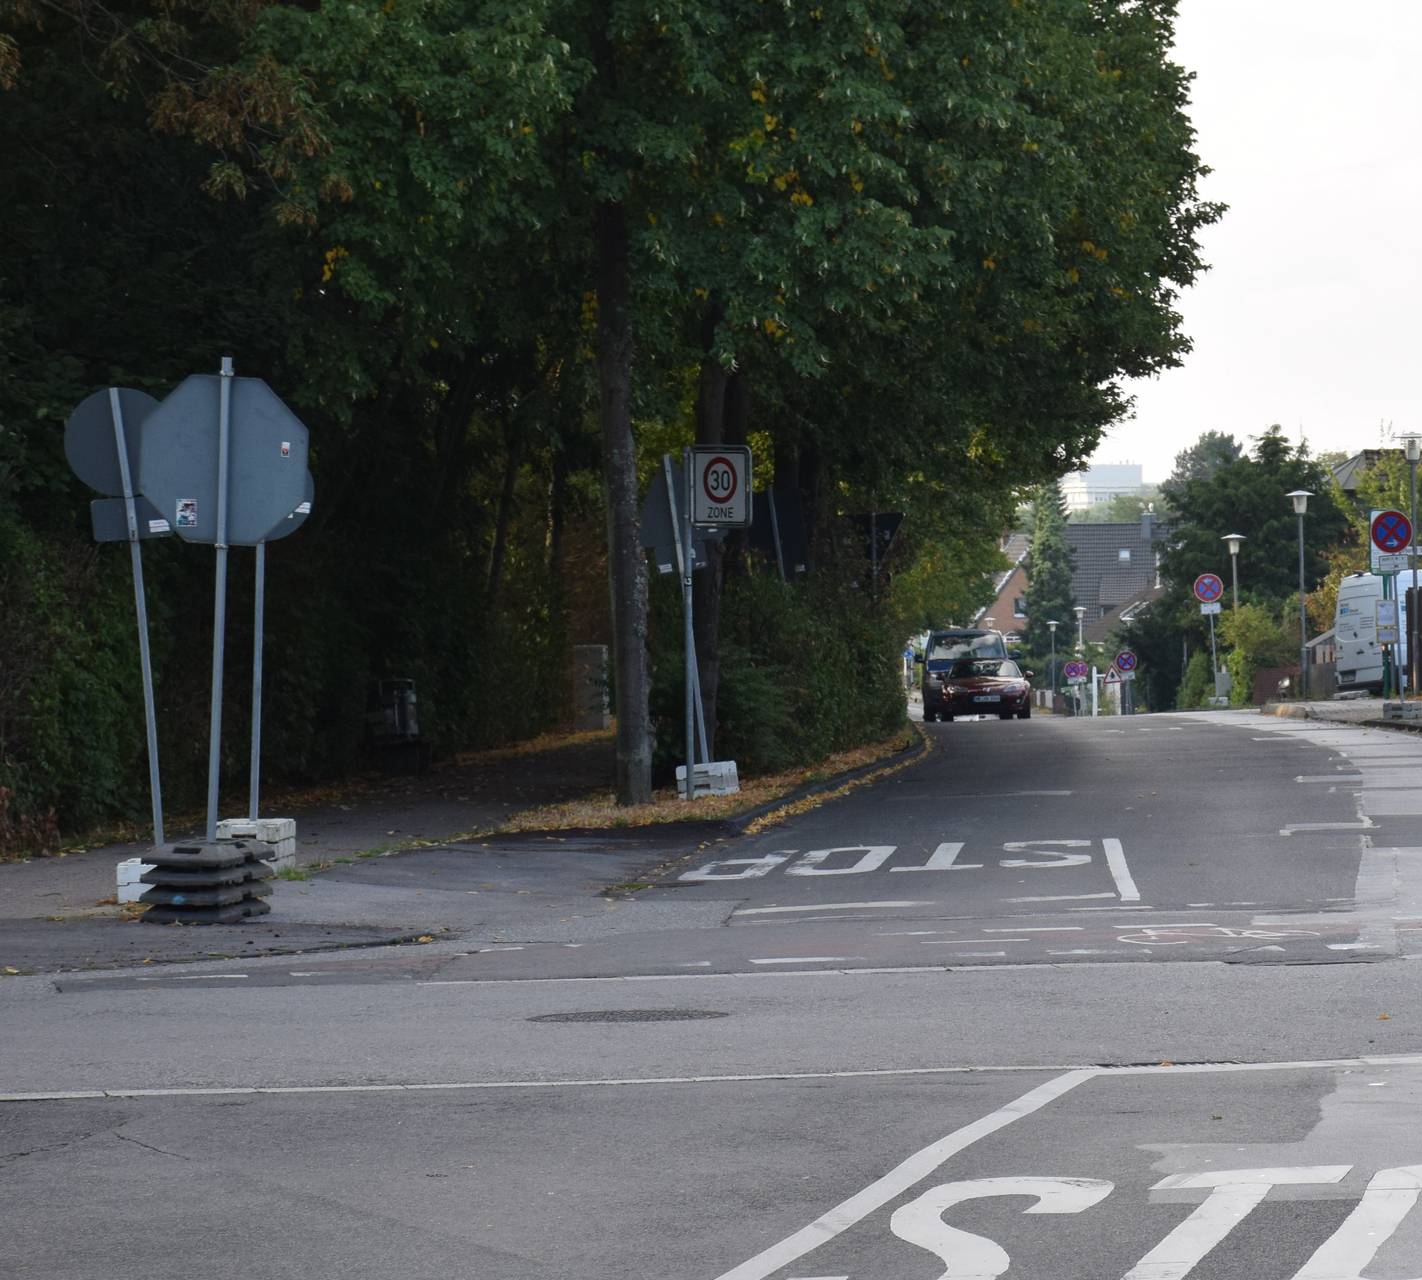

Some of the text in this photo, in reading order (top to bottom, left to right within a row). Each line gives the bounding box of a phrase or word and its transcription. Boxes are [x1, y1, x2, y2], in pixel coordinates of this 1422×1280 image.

[710, 470, 731, 491] 30
[707, 506, 734, 519] ZONE
[677, 839, 1092, 881] STOP
